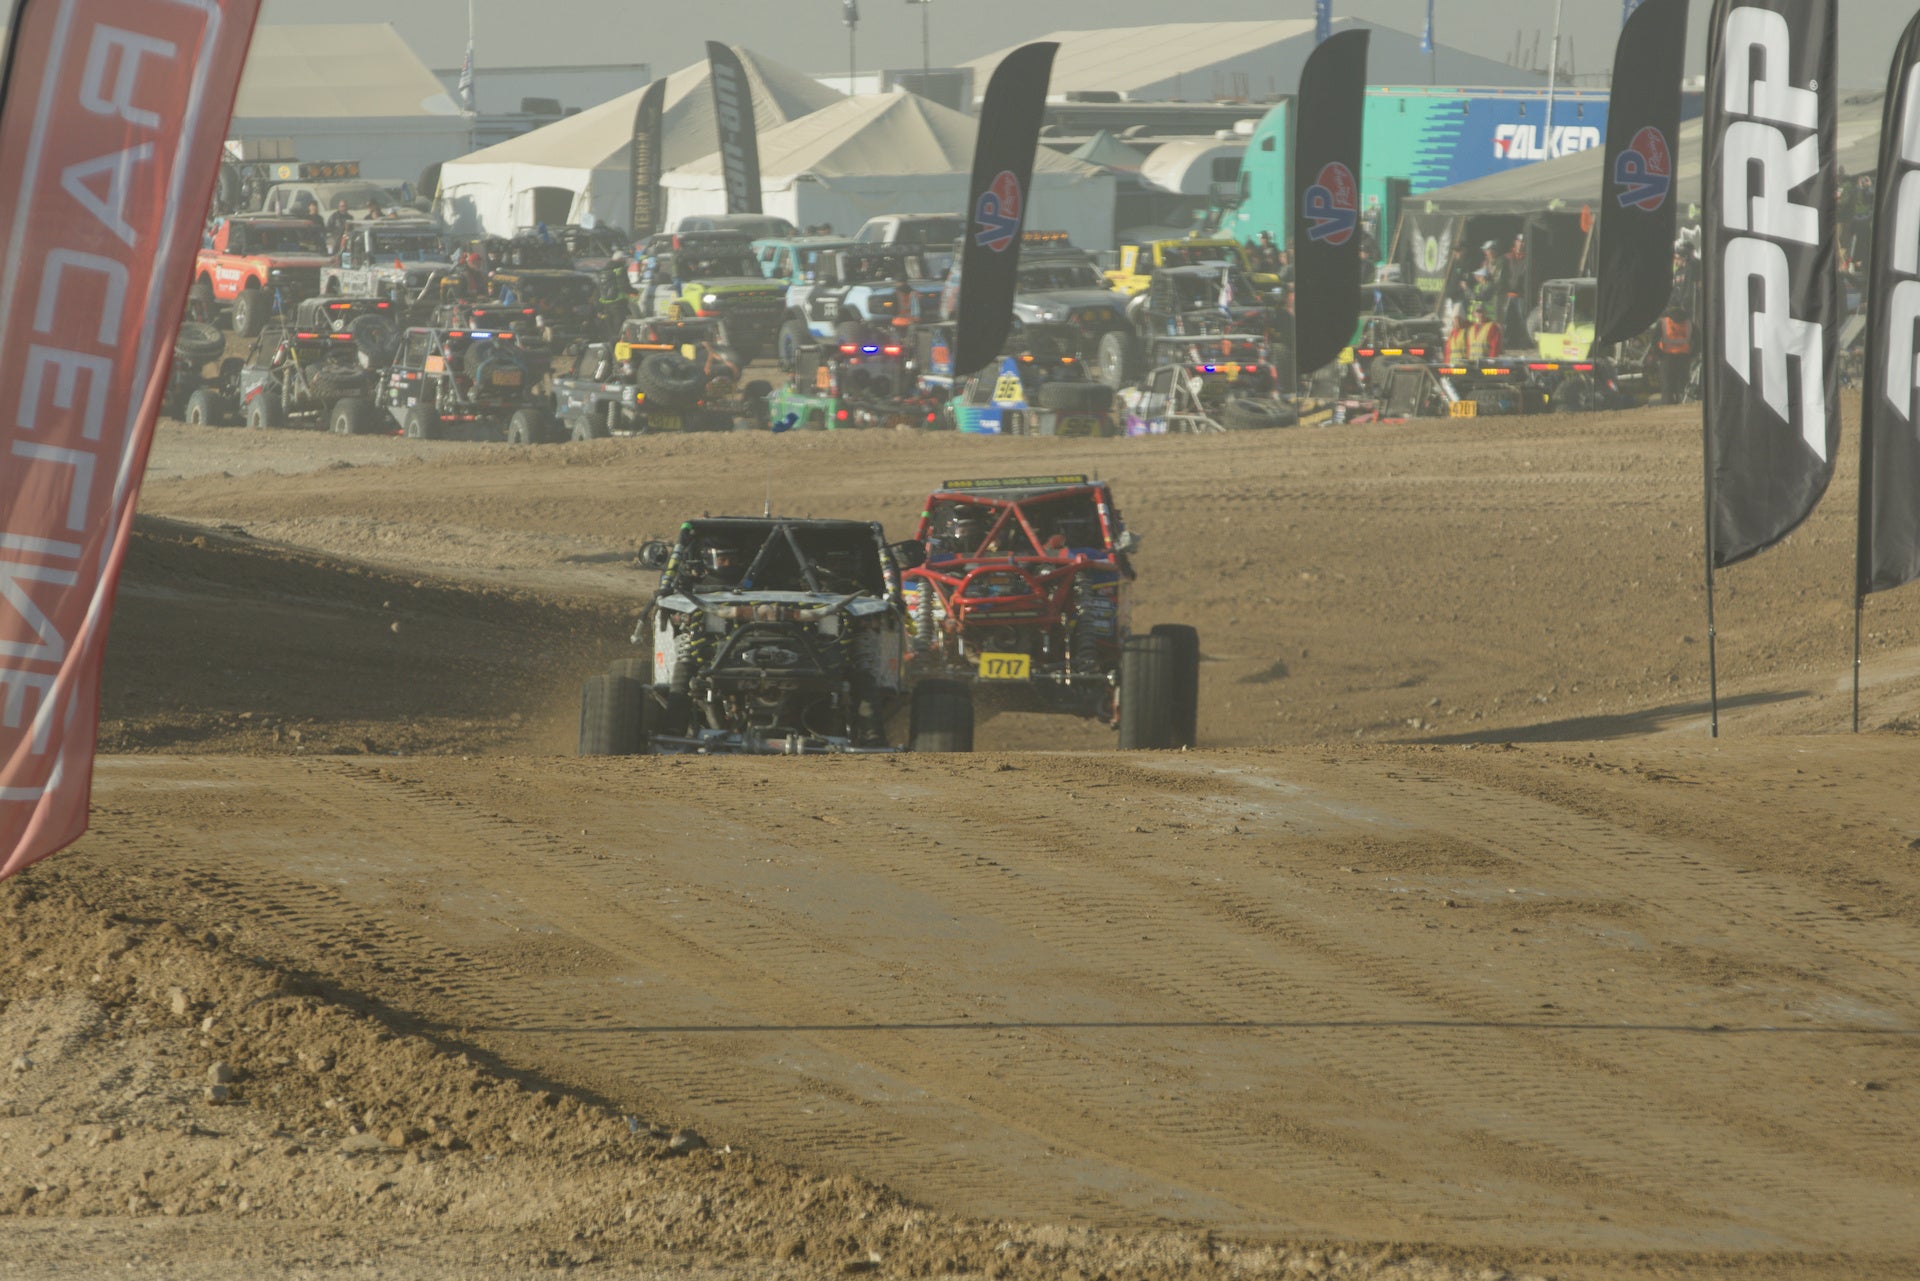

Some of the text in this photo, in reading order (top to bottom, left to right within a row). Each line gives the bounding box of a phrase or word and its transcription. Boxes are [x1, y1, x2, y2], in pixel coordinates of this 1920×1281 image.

[1613, 149, 1671, 208] VP
[634, 188, 651, 229] TERRY
[975, 192, 1017, 247] VP
[1302, 184, 1357, 241] VP
[1723, 6, 1828, 463] PRP
[987, 659, 1024, 676] 1717
